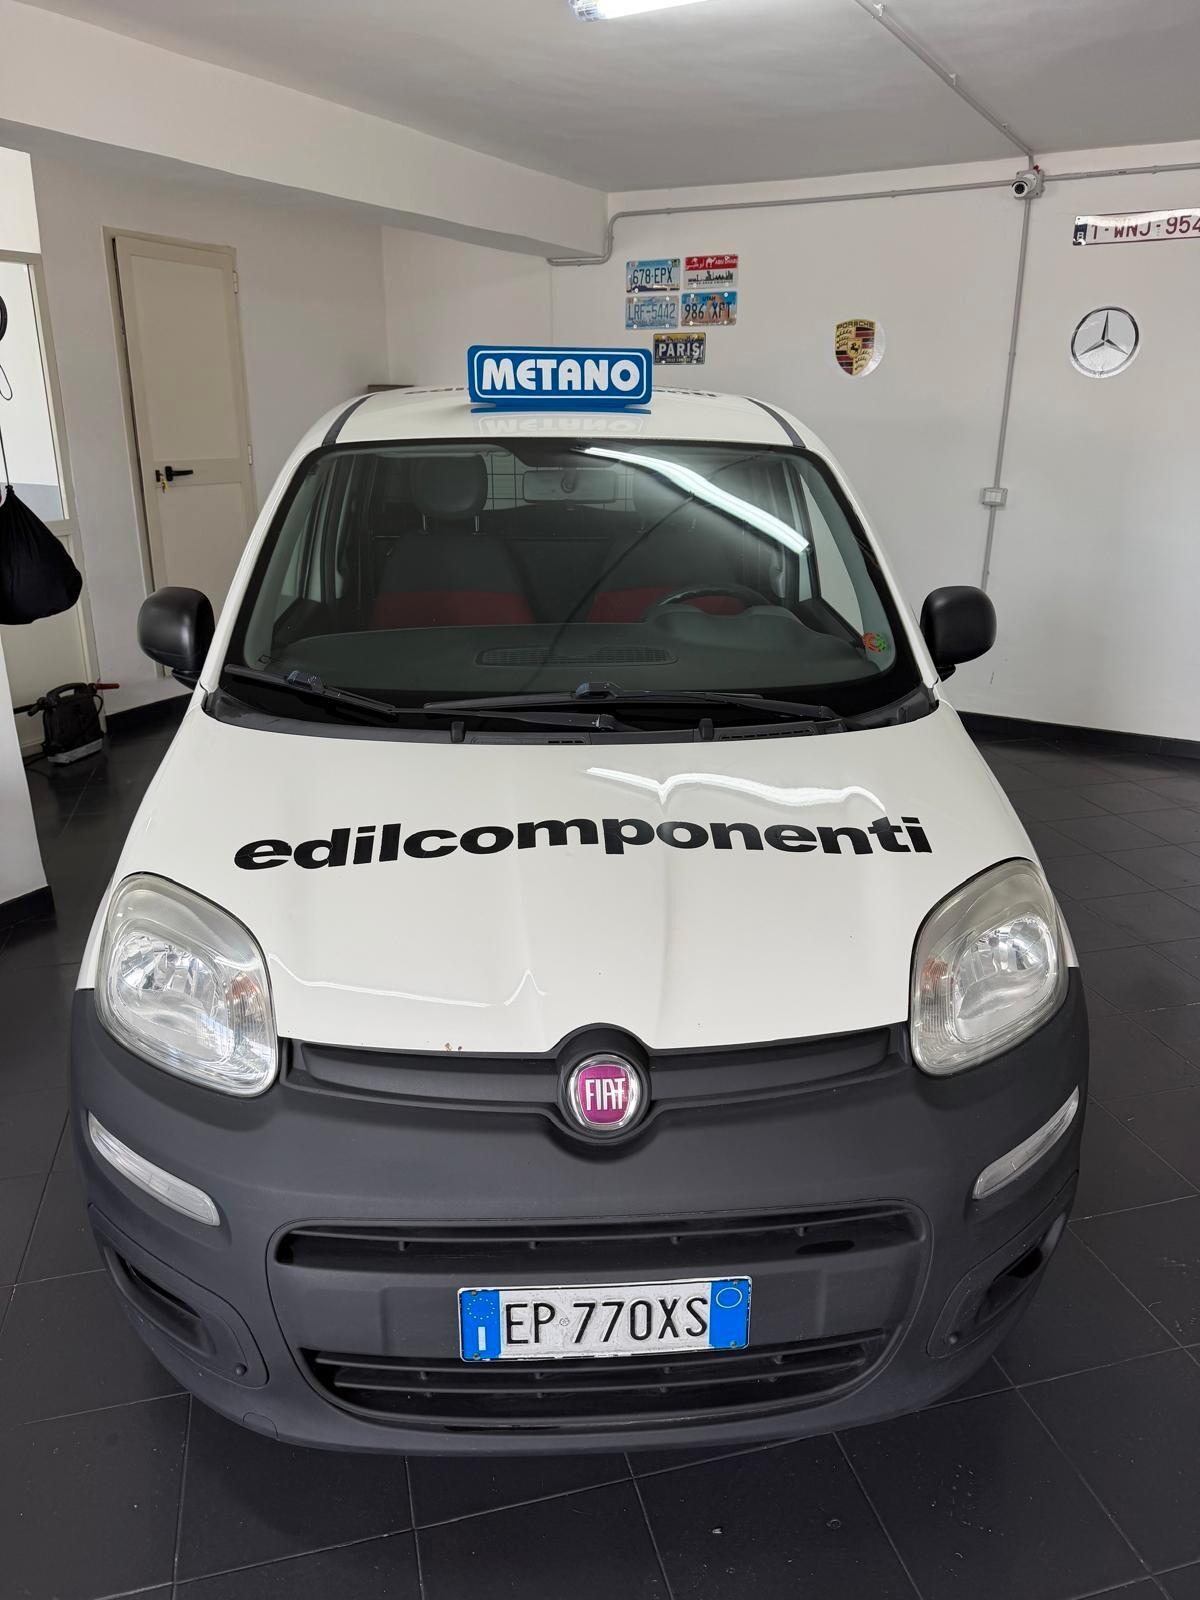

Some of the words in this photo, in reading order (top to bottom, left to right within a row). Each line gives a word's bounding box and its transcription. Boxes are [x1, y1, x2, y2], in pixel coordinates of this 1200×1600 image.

[684, 304, 705, 320] 986
[658, 342, 700, 357] PARIS
[481, 358, 641, 391] METANO
[234, 817, 932, 870] edilcomponenti
[585, 1078, 626, 1111] FIAT
